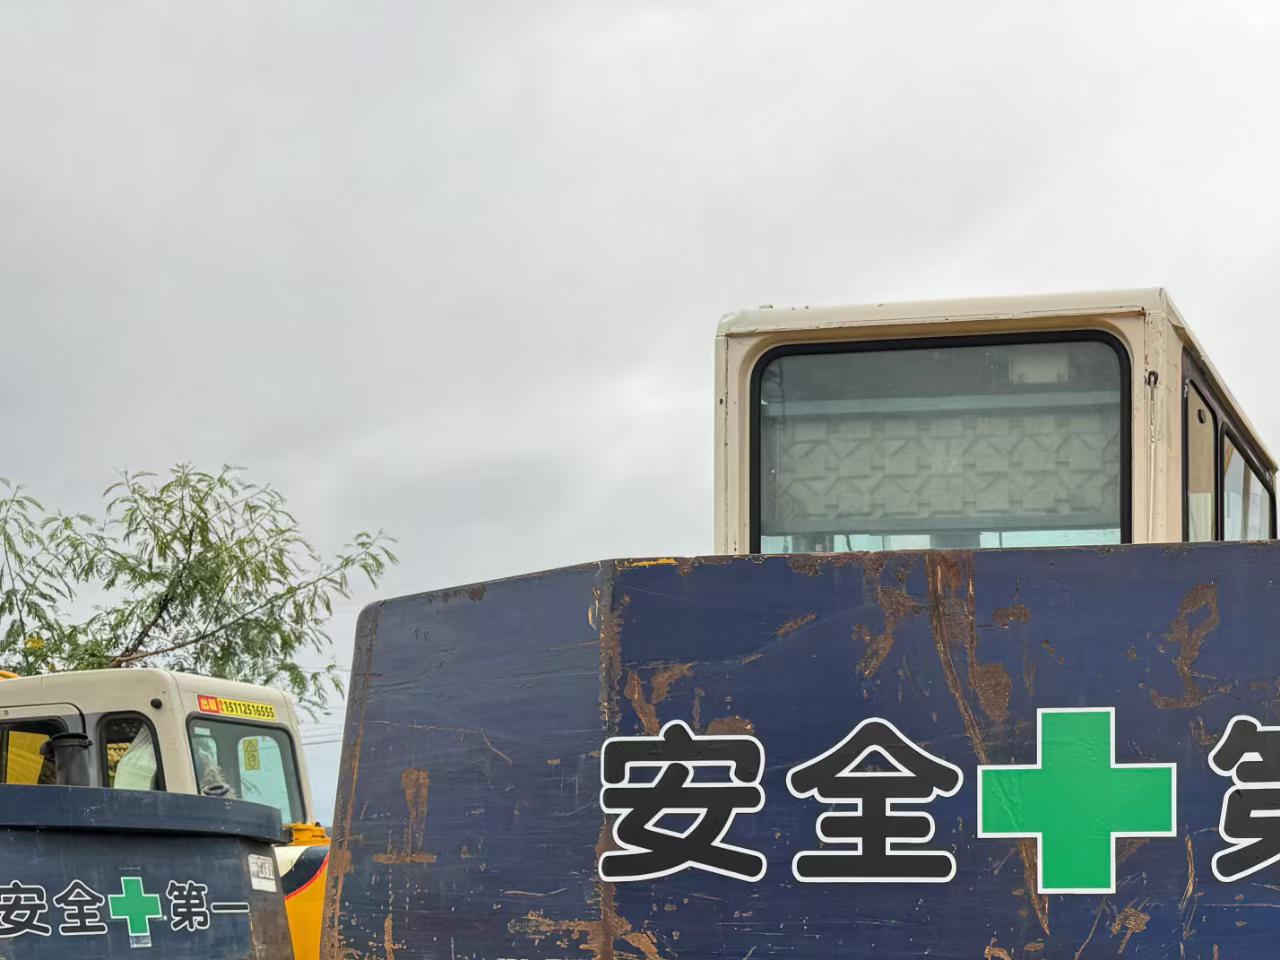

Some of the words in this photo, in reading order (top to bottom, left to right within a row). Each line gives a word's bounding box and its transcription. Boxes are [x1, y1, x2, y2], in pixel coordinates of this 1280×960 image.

[600, 717, 963, 883] 安全
[0, 880, 108, 937] 安全
[166, 880, 249, 931] 第一
